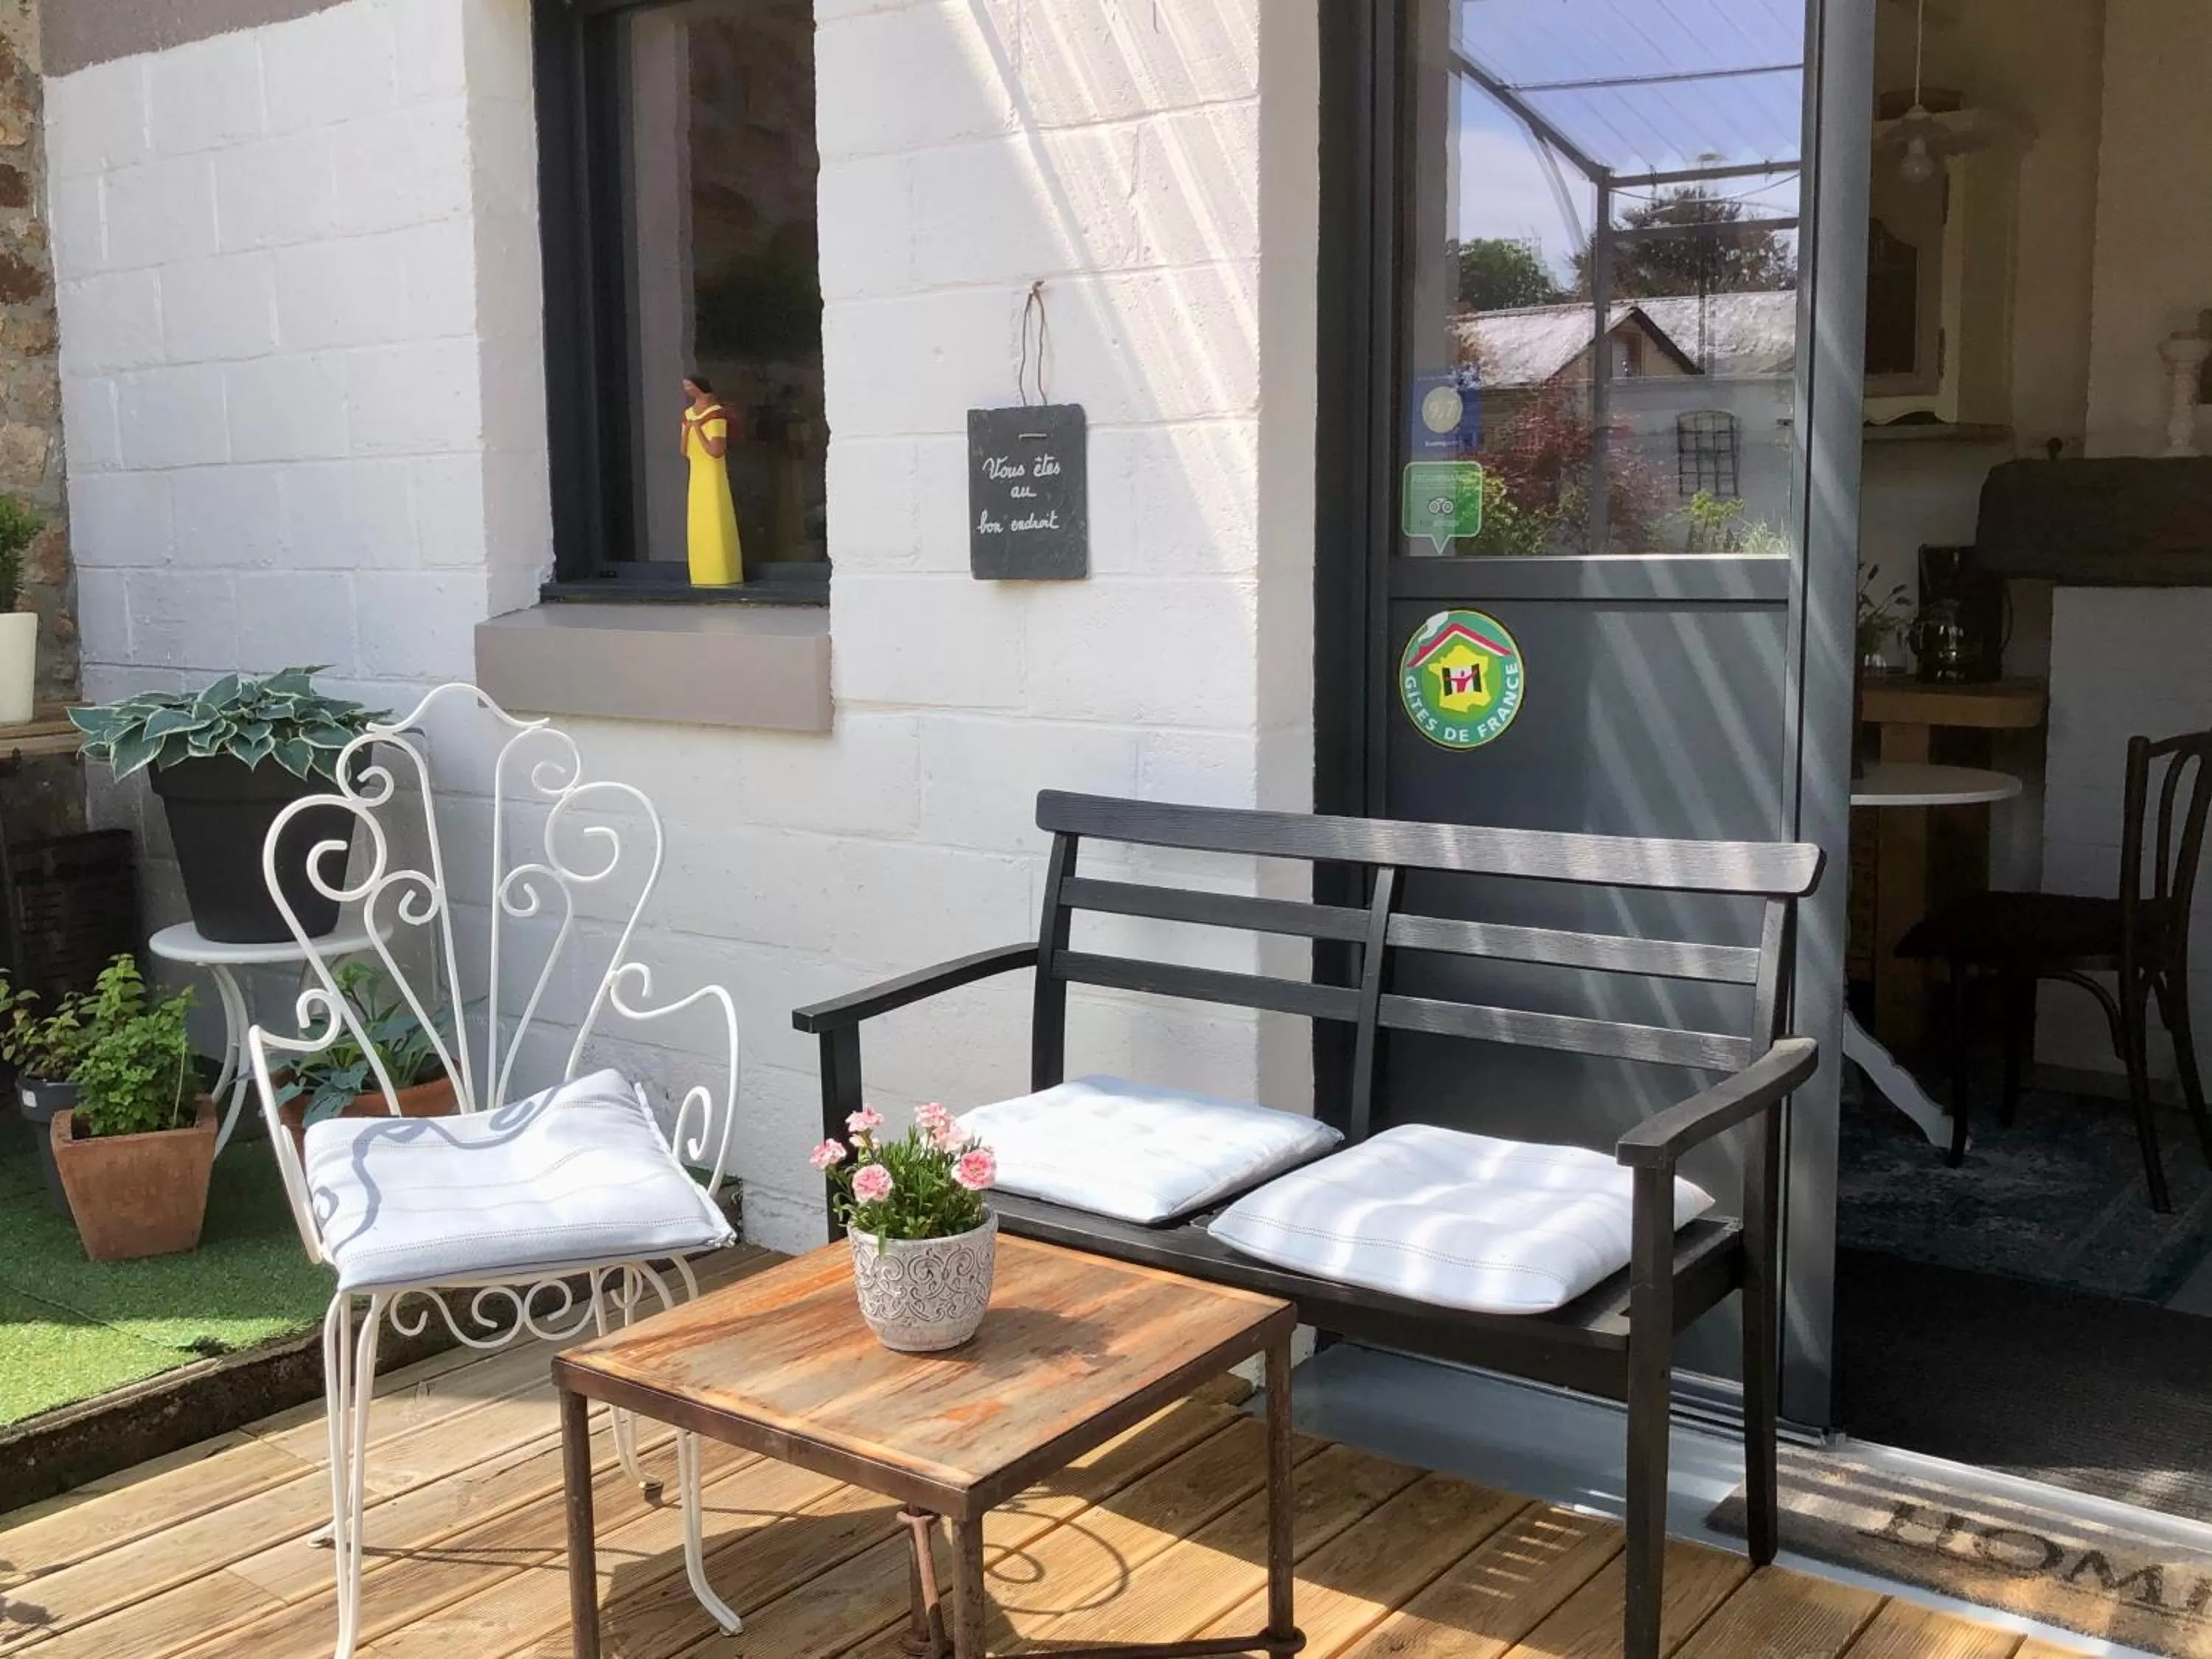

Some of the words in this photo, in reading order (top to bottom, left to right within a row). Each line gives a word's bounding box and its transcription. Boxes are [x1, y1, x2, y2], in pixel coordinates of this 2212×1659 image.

[982, 456, 1026, 479] Vous
[1033, 453, 1061, 477] êtes
[1010, 485, 1037, 498] au
[977, 509, 1004, 534] bon
[1011, 510, 1060, 532] endroit
[1443, 726, 1470, 750] DE
[1476, 662, 1520, 738] FRANCE
